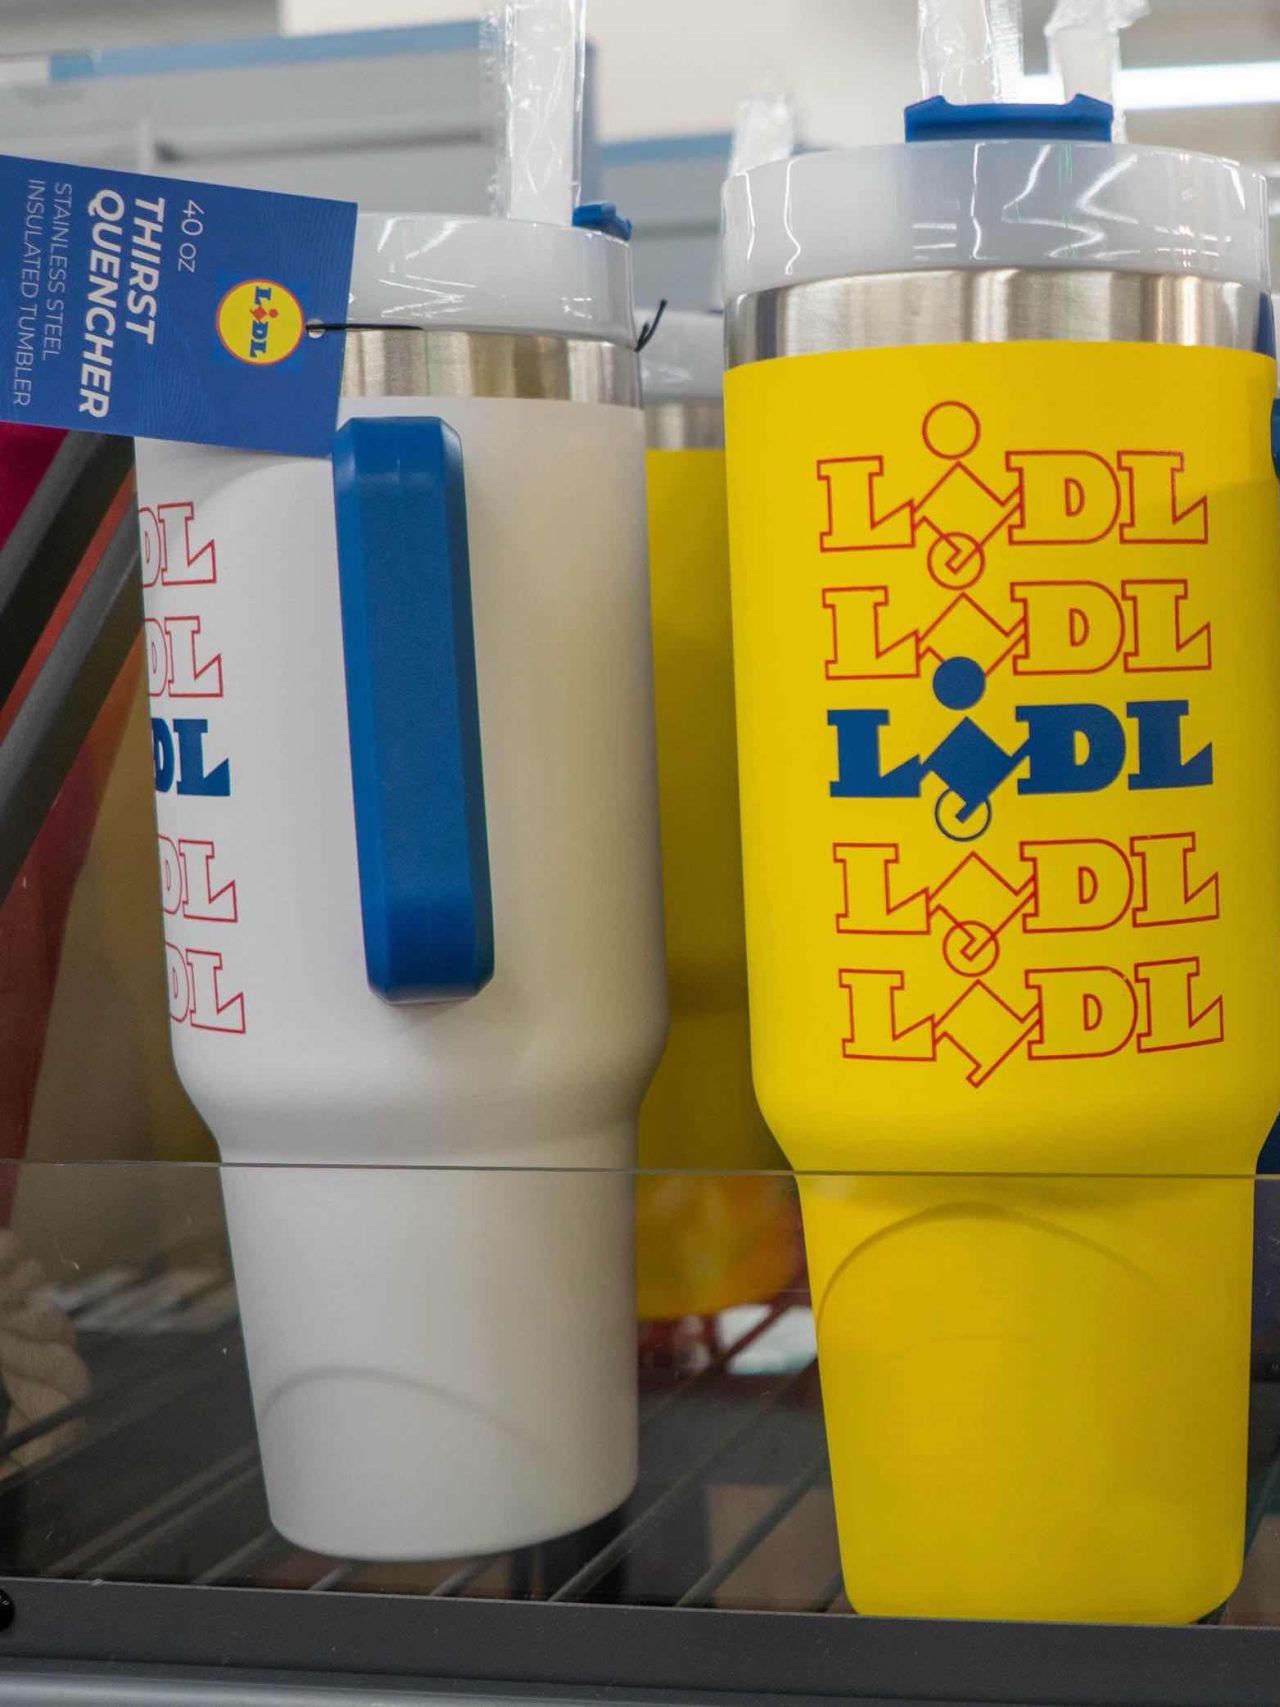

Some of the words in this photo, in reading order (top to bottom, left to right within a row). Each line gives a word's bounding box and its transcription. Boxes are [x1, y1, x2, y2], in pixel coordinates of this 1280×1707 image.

[20, 179, 46, 298] INSULATED
[47, 182, 73, 295] STAINLESS
[125, 197, 165, 345] THIRST
[181, 199, 205, 236] 40
[13, 302, 38, 406] TUMBLER
[42, 299, 65, 361] STEEL
[78, 189, 125, 418] QUENCHER
[249, 286, 278, 358] LIDL
[817, 401, 1209, 574] LIDL
[138, 501, 217, 588] DL
[143, 616, 223, 698] DL
[822, 532, 1213, 680] LIDL
[150, 717, 231, 797] DL
[827, 656, 1214, 824] LIDL
[157, 834, 238, 923] DL
[832, 785, 1220, 962] LIDL
[164, 941, 246, 1034] DL
[838, 920, 1225, 1088] LIDL
